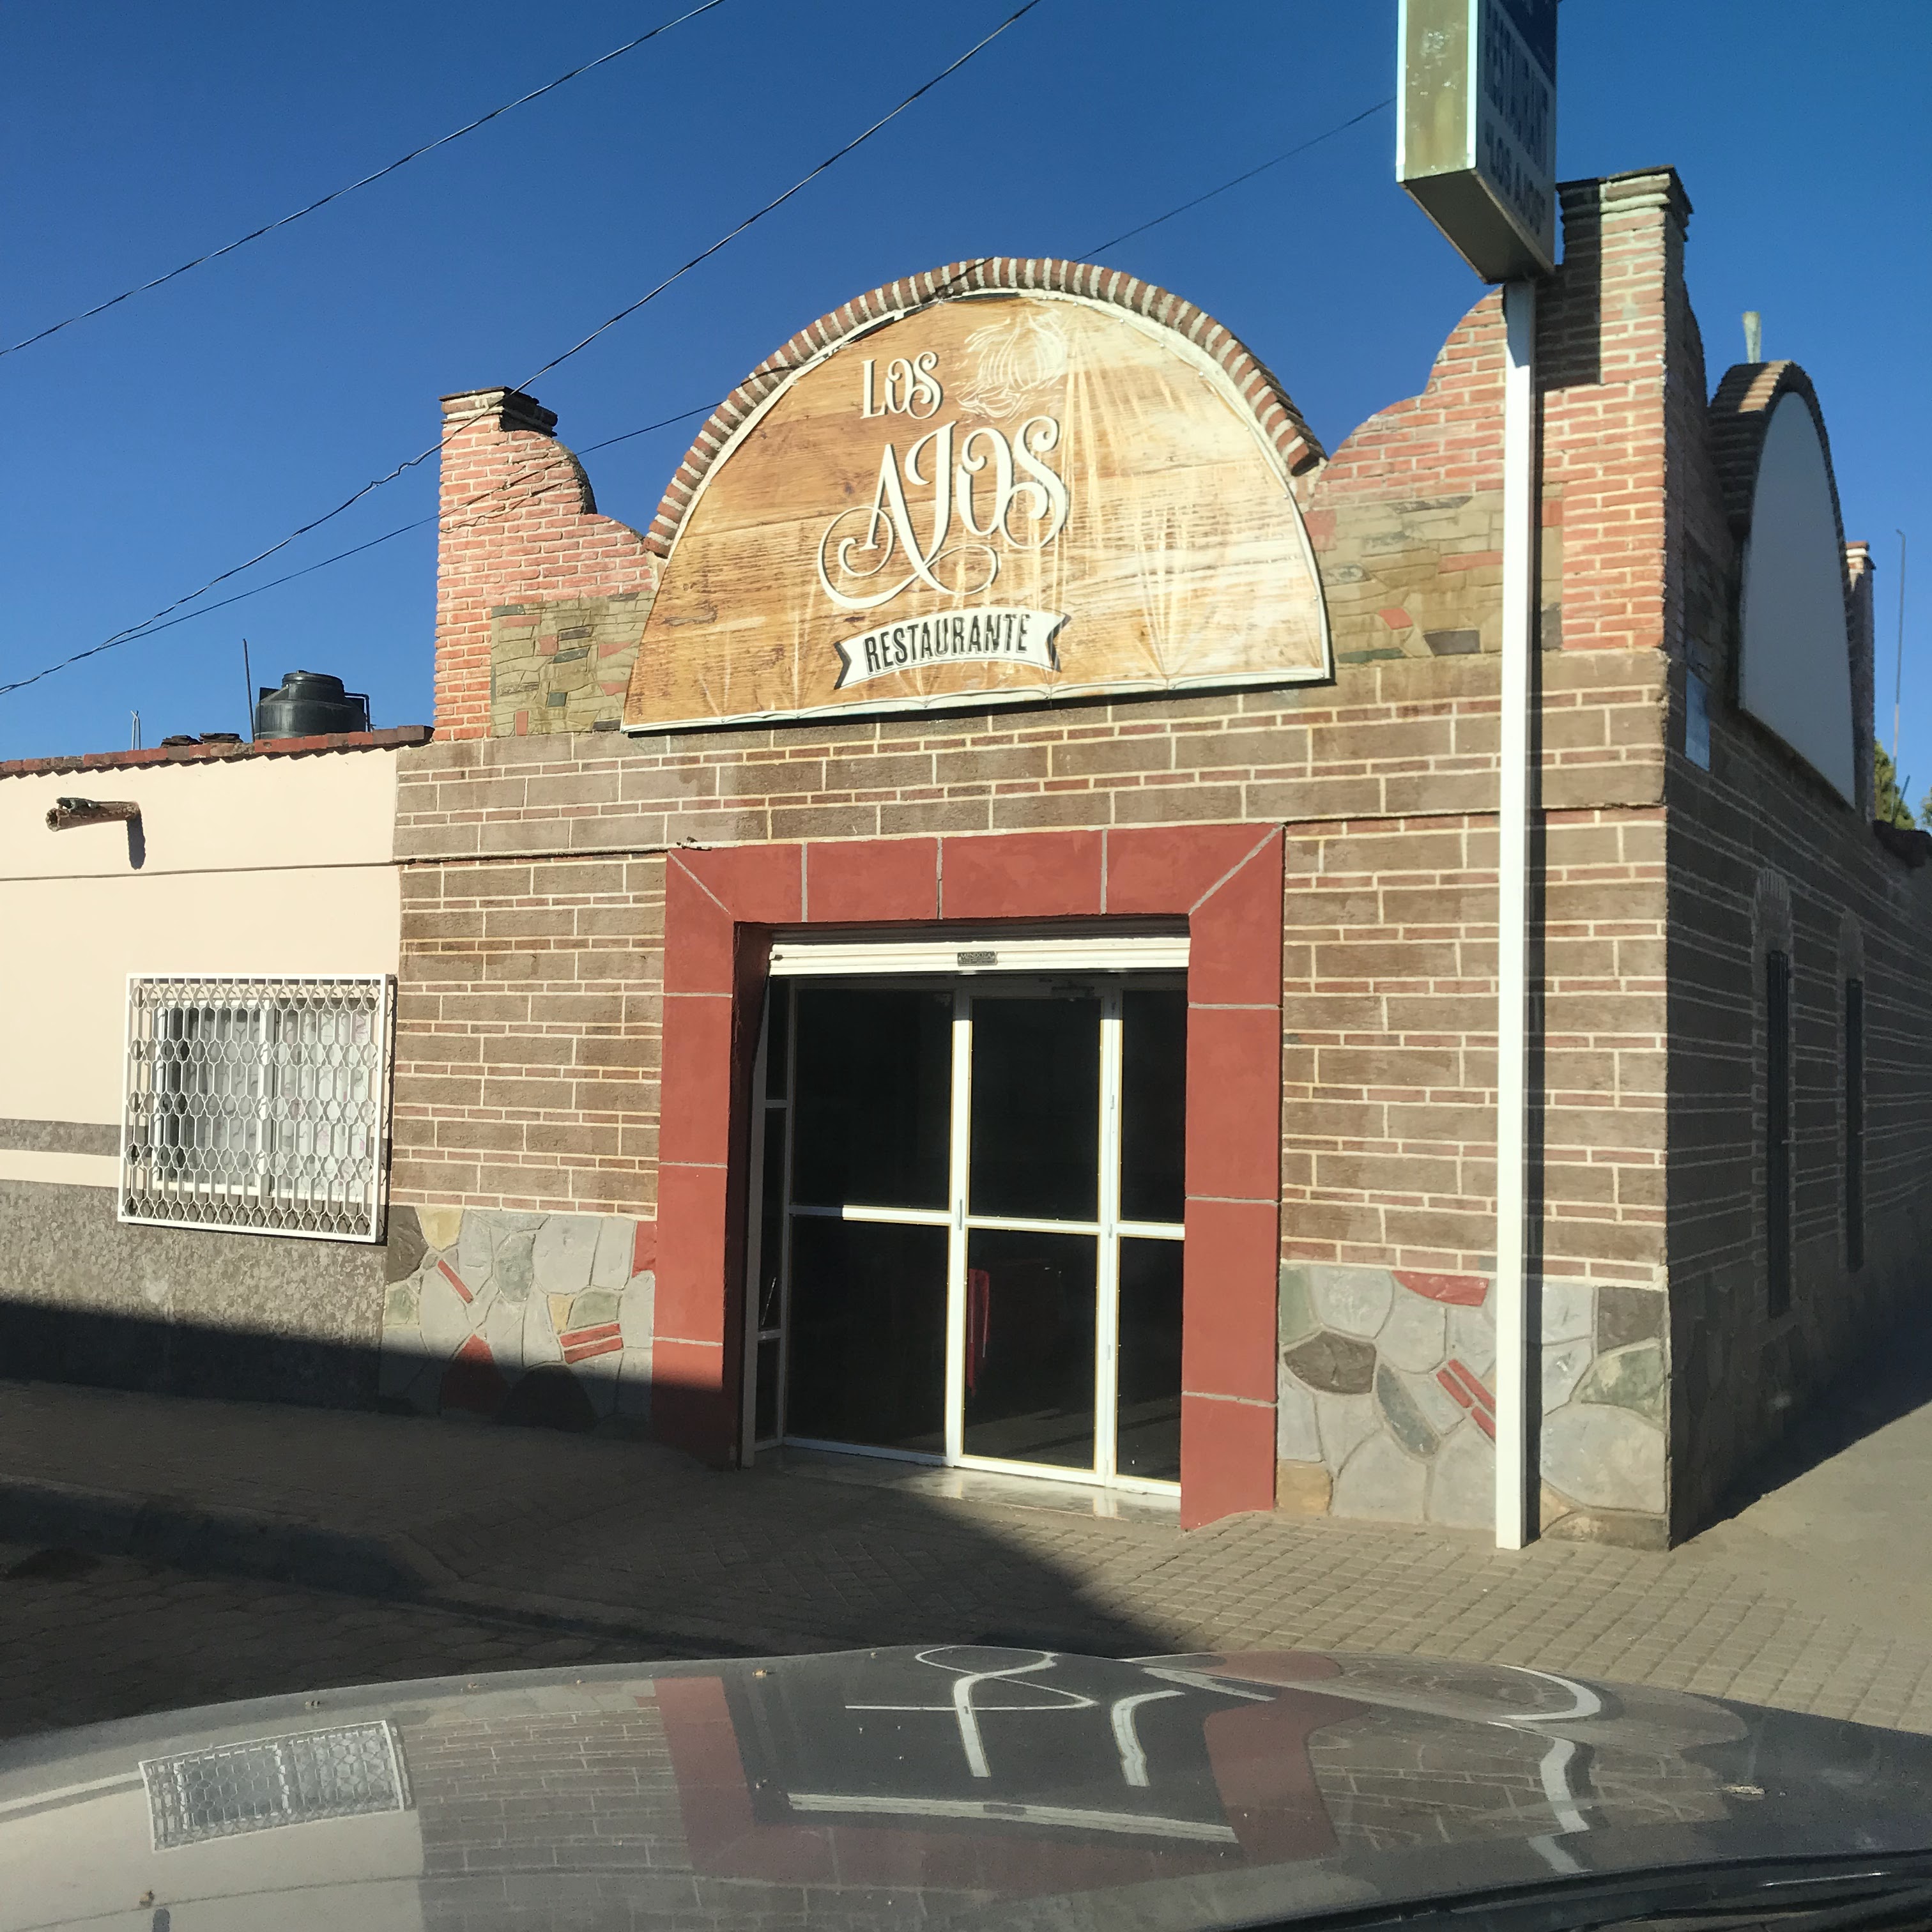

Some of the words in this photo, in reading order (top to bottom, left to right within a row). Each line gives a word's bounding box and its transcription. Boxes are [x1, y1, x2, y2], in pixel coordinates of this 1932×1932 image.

[860, 351, 943, 419] LOS
[818, 415, 1070, 609] AJOS
[863, 614, 1031, 675] RESTAURANTE
